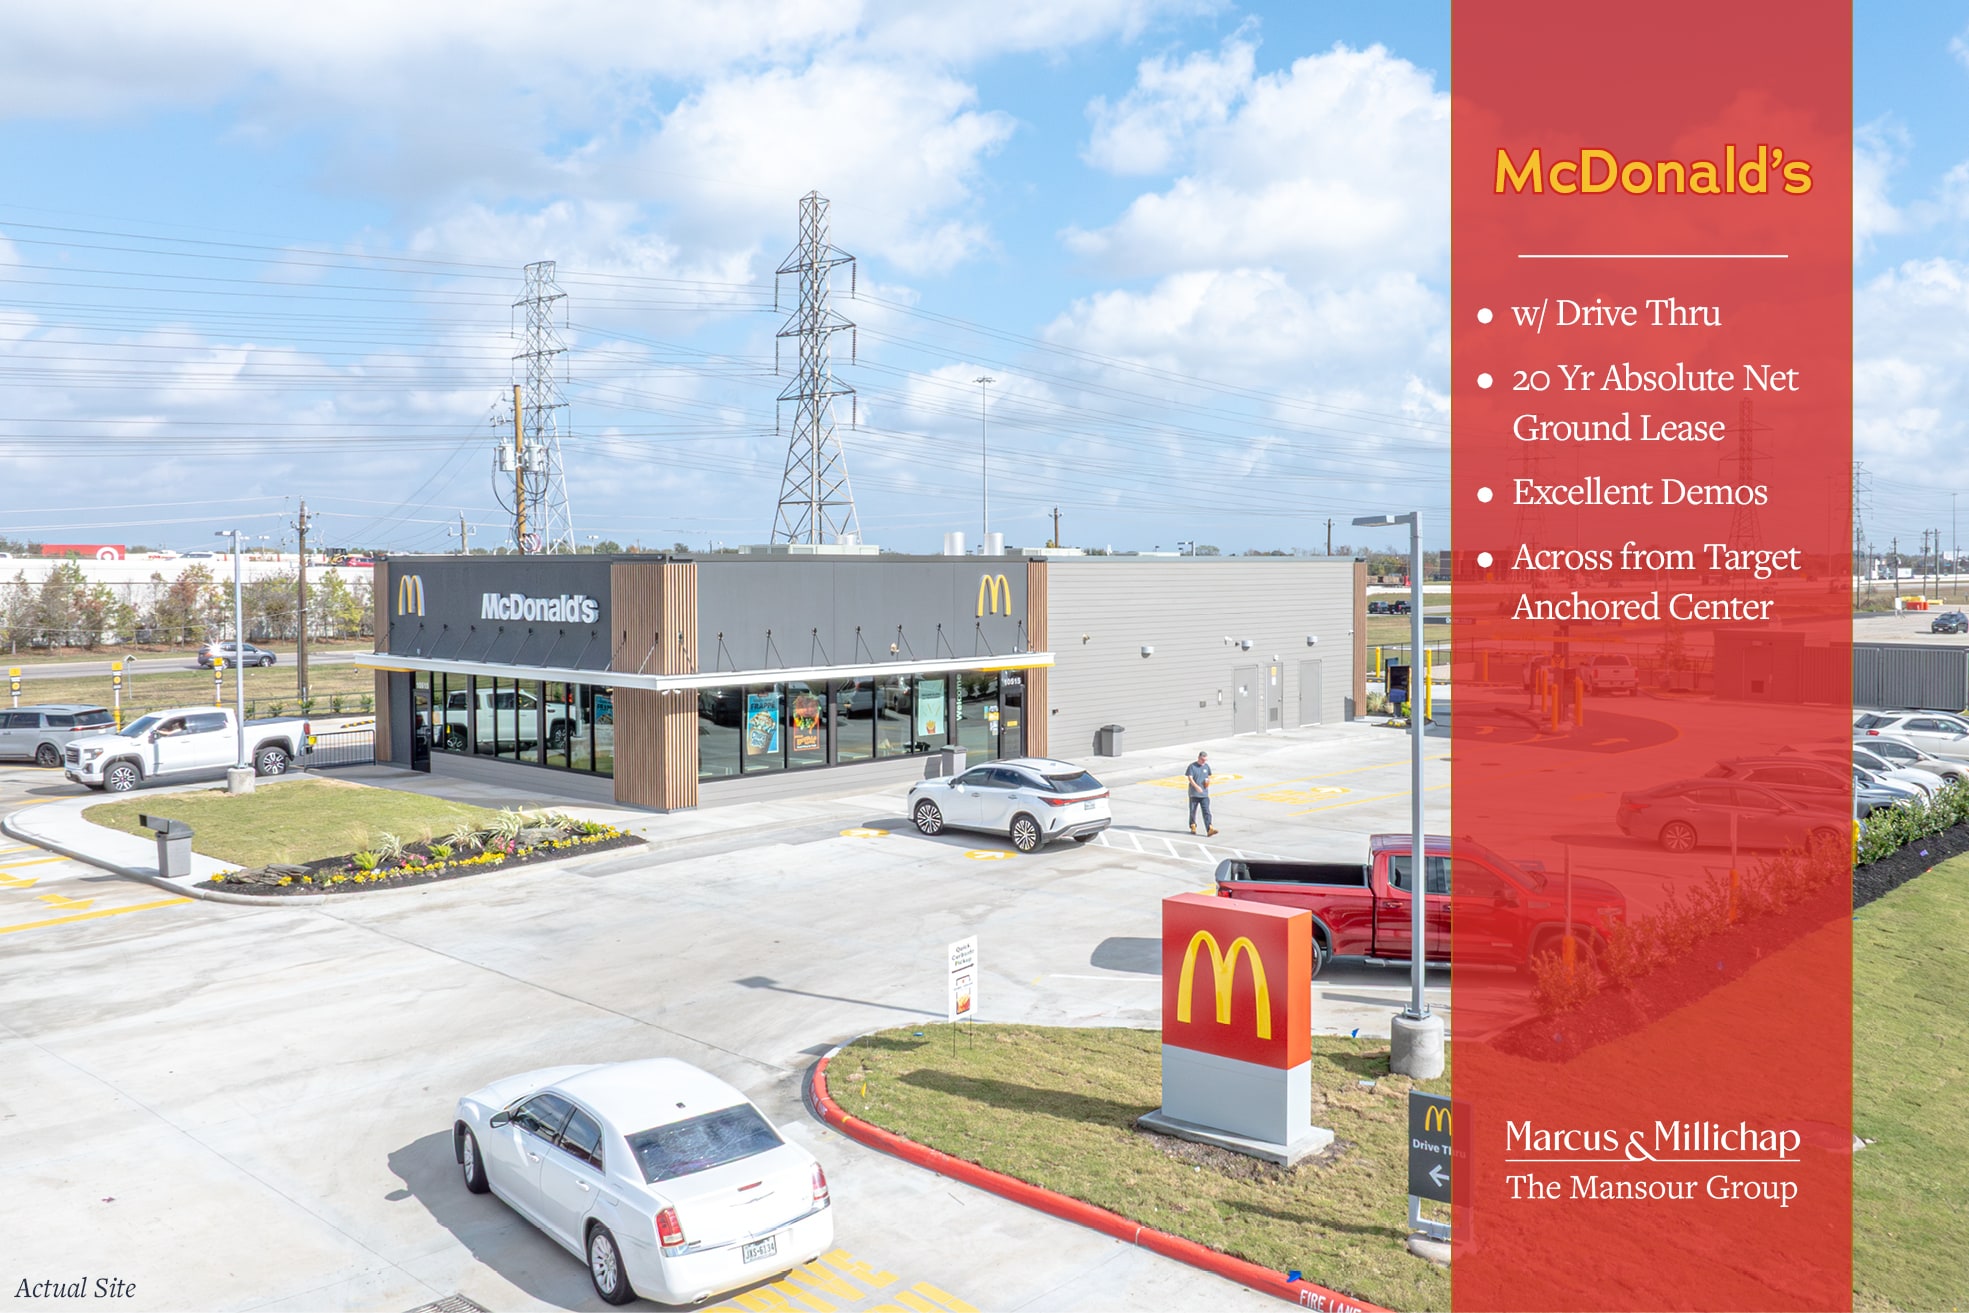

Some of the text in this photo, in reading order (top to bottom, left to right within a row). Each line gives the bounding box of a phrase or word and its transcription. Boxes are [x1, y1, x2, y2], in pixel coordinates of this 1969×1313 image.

[480, 592, 600, 624] McDonald's
[1412, 1138, 1440, 1153] Drive
[1299, 1288, 1327, 1313] FIRE
